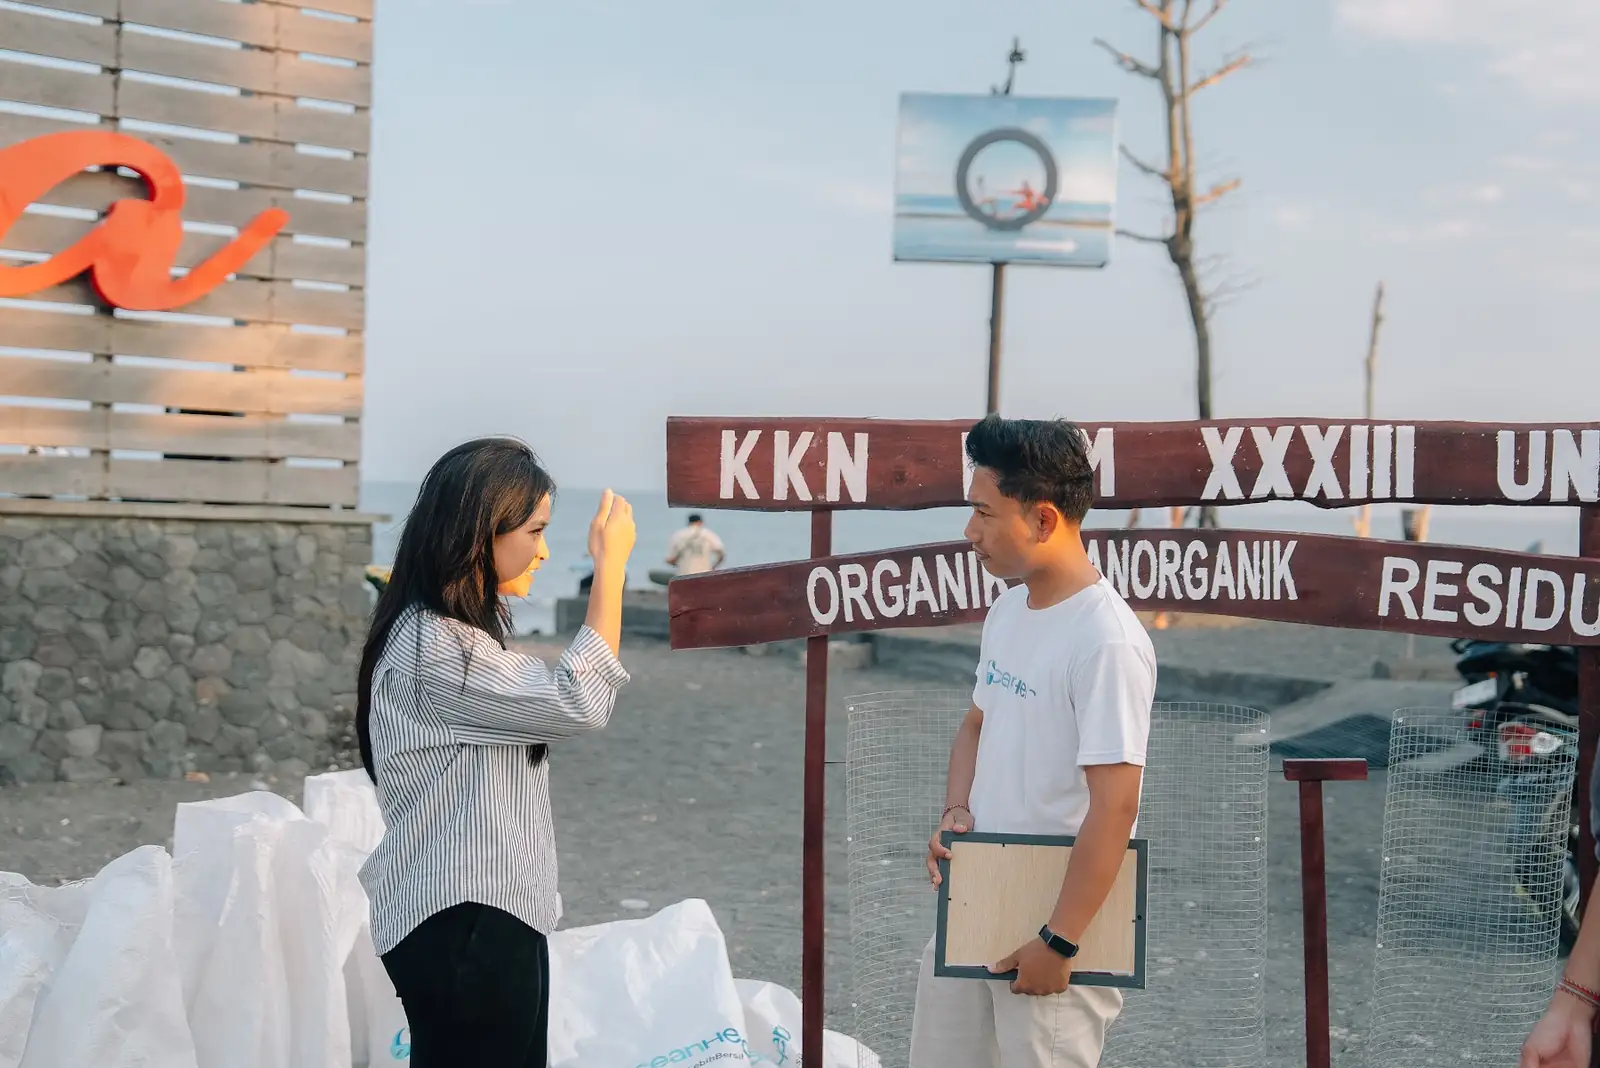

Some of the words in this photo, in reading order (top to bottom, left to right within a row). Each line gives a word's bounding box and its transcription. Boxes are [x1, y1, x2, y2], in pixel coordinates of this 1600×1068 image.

[719, 429, 869, 502] KKN
[1200, 425, 1415, 500] XXXIII
[1496, 429, 1600, 502] UN
[1378, 556, 1600, 636] RESIDU
